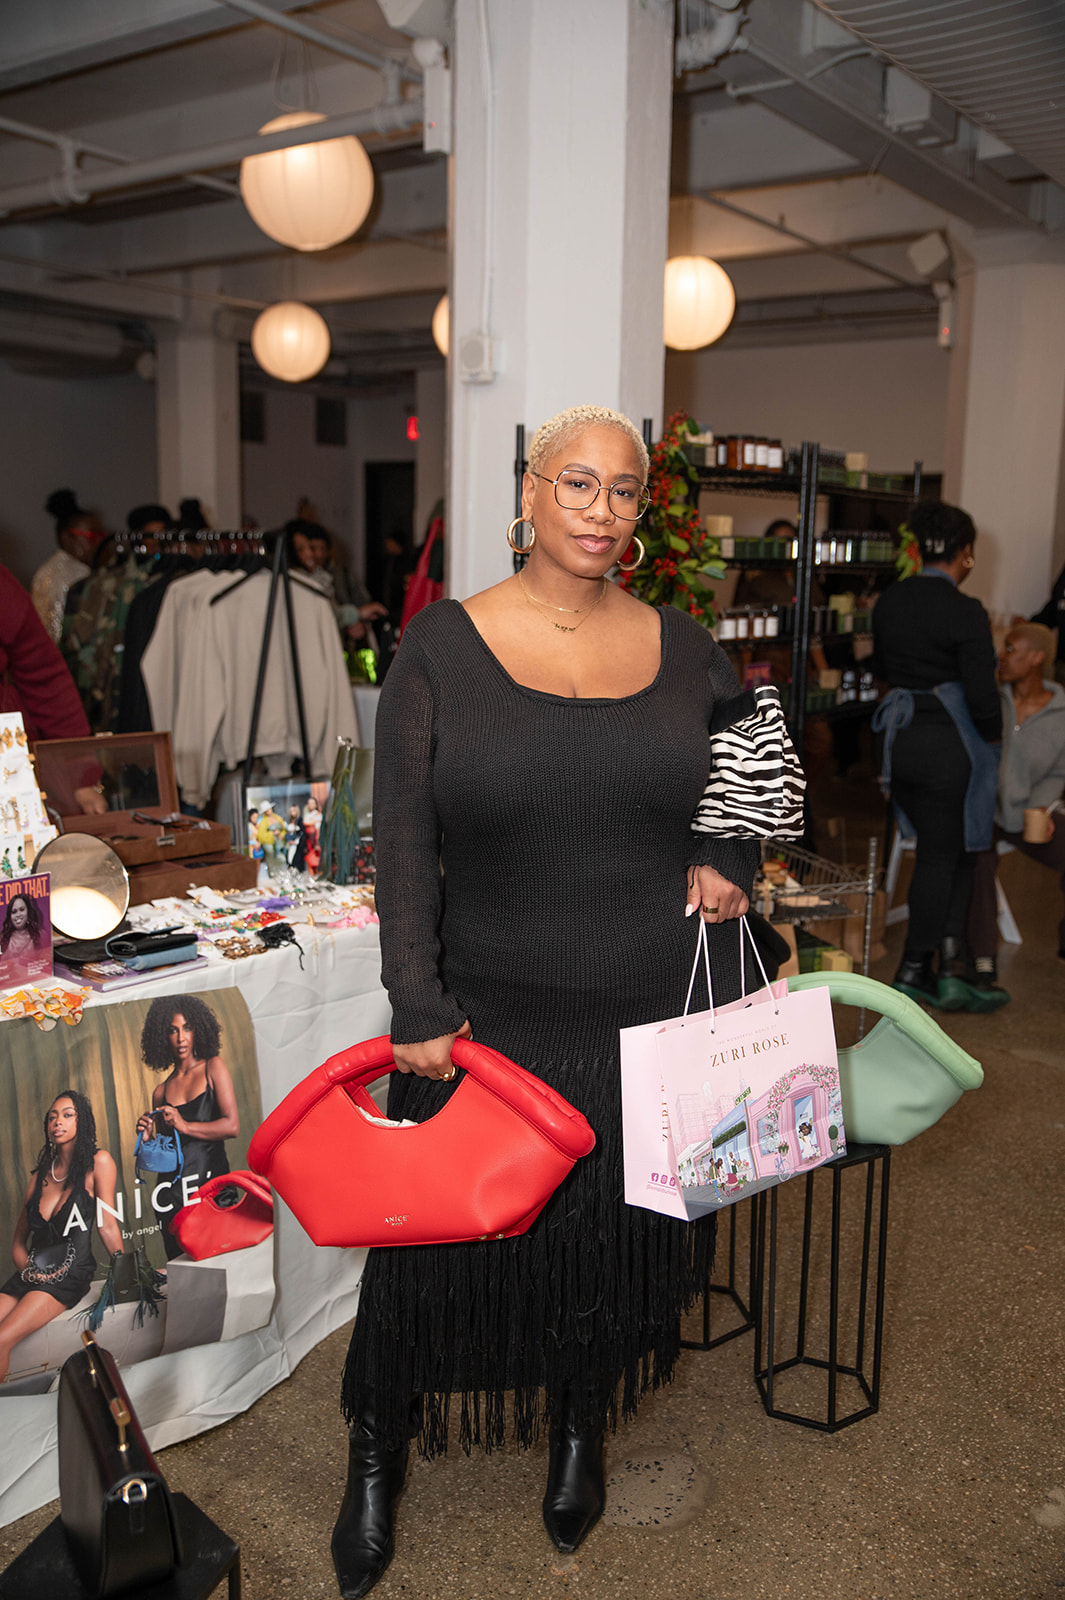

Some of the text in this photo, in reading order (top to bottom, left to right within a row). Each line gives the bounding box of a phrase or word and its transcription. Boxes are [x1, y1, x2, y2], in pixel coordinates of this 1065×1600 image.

[22, 876, 49, 899] THAT.
[710, 1032, 790, 1067] ZURI ROSE
[122, 1221, 162, 1240] by angel
